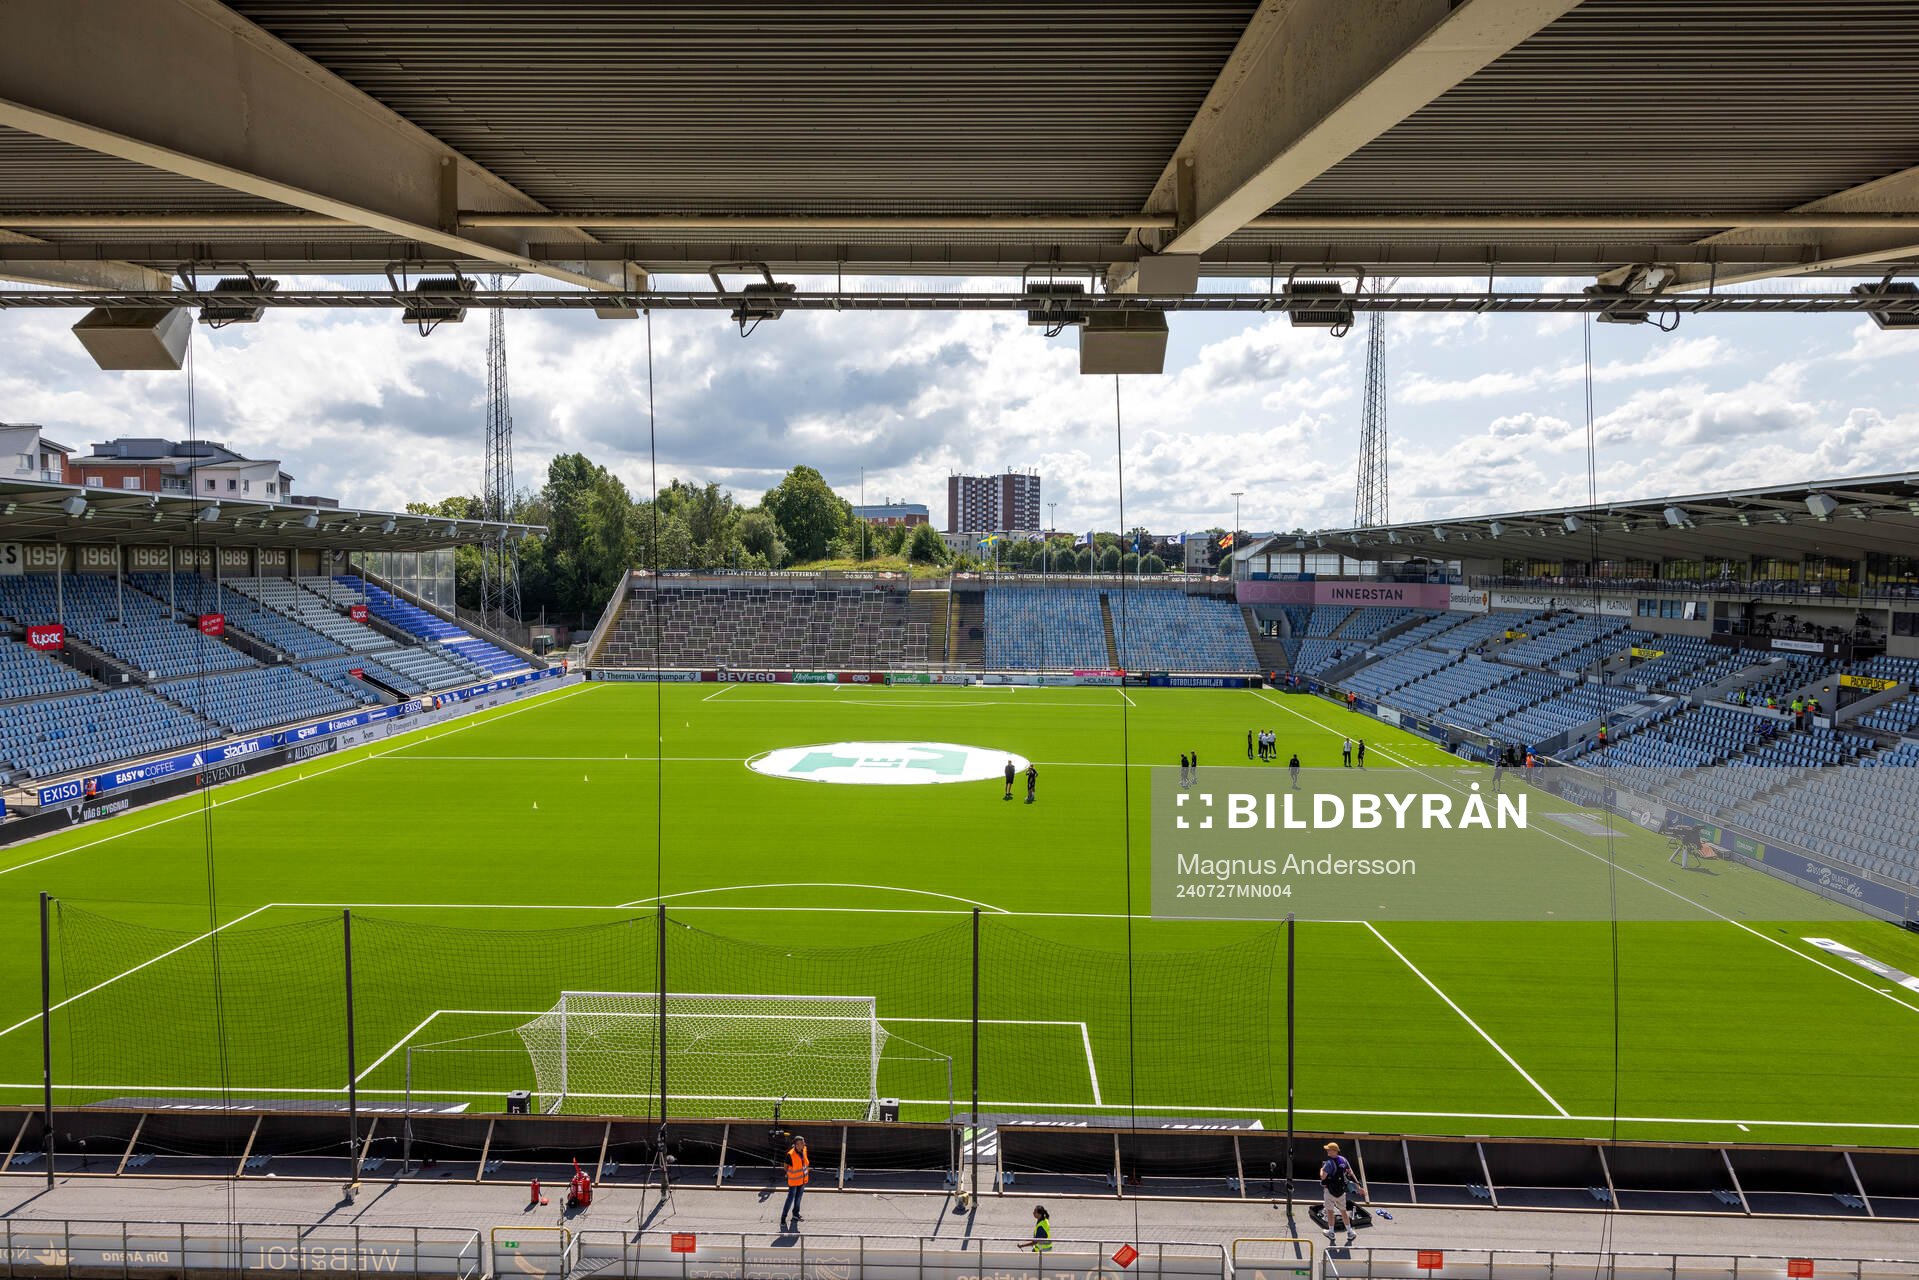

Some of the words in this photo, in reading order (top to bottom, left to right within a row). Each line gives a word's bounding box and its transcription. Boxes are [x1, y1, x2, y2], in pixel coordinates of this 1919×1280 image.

[24, 546, 67, 566] 1957
[133, 549, 169, 566] 1962
[220, 550, 249, 566] 1989
[259, 551, 286, 565] 2015
[1331, 588, 1403, 600] INNERSTAN
[31, 631, 61, 646] tupac
[606, 672, 635, 680] Thermia
[636, 672, 686, 681] Värmepumpar
[717, 672, 776, 682] BEVEGO
[405, 701, 422, 713] EXISO
[223, 739, 259, 759] stadium
[294, 740, 329, 760] ALLSVENSKAN
[116, 772, 137, 784] EASY
[144, 761, 175, 777] COFFEE
[44, 784, 78, 802] EXISO
